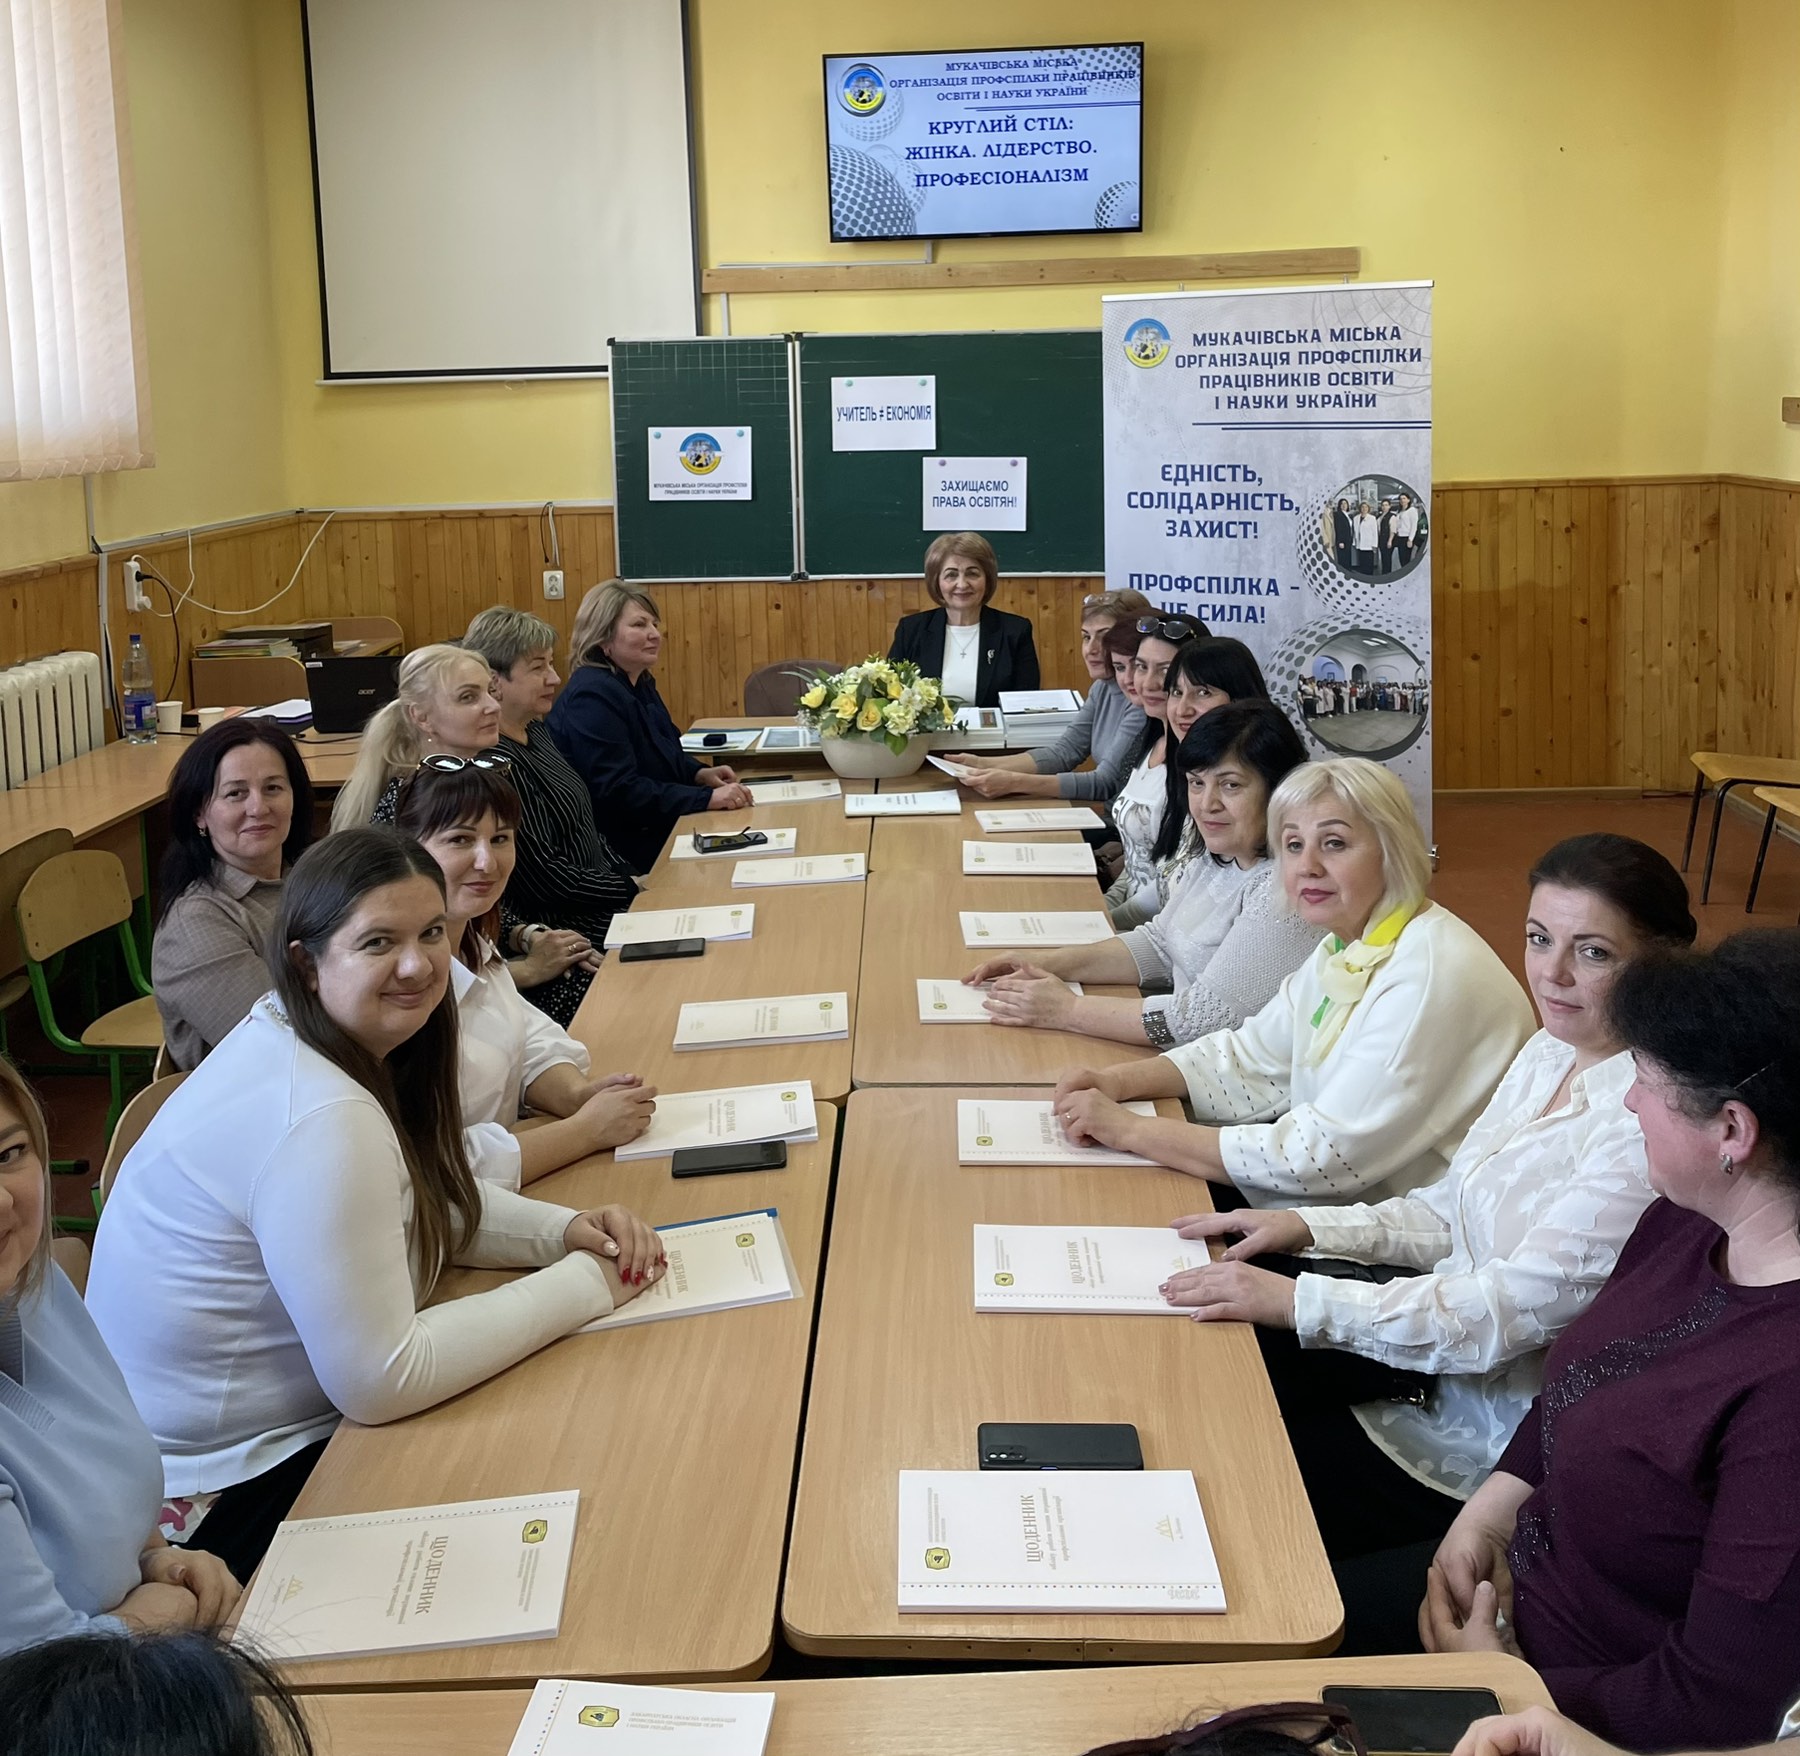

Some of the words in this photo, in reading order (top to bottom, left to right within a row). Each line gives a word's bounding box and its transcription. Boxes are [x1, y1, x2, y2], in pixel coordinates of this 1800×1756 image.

[945, 59, 1029, 71] МУКАЧІВСЬКА
[1033, 57, 1078, 69] МІСЬКА
[889, 76, 967, 89] ОРГАНІЗАЦІЯ
[971, 73, 1049, 86] ПРОФСПІЛКИ
[937, 90, 981, 101] ОСВІТИ
[984, 90, 988, 100] І
[992, 89, 1032, 100] НАУКИ
[1035, 86, 1087, 99] УКРАЇНИ
[928, 115, 1017, 135] КРУГЛИЙ
[1024, 116, 1074, 132] СТІЛ:
[905, 145, 976, 160] ЖІНКА.
[983, 141, 1097, 159] ЛІДЕРСТВО.
[915, 168, 1089, 188] ПРОФЕСІОНАЛІЗМ
[1192, 328, 1322, 347] МУКАЧІВСЬКА
[1329, 326, 1402, 342] МІСЬКА
[1175, 352, 1291, 370] ОРГАНІЗАЦІЯ
[1299, 348, 1422, 366] ПРОФСПІЛКИ
[1199, 372, 1321, 391] ПРАЦІВНИКІВ
[1327, 371, 1394, 387] ОСВІТИ
[1214, 396, 1219, 410] І
[1227, 394, 1289, 410] НАУКИ
[1296, 391, 1377, 409] УКРАЇНИ
[836, 406, 877, 422] УЧИТЕЛЬ
[886, 405, 932, 421] ЕКОНОМІЯ
[1161, 464, 1263, 487] ЄДНІСТЬ,
[940, 480, 1009, 494] ЗАХИЩАЄМО
[932, 496, 966, 508] ПРАВА
[969, 496, 1017, 508] ОСВІТЯН!
[1127, 491, 1300, 515] СОЛІДАРНІСТЬ,
[1165, 520, 1259, 539] ЗАХИСТ!
[1128, 573, 1280, 597] ПРОФСПІЛКА
[1197, 604, 1266, 624] СИЛА!
[1020, 1494, 1044, 1562] ЩОДЕННИК
[415, 1535, 449, 1615] ЩОДЕННИК
